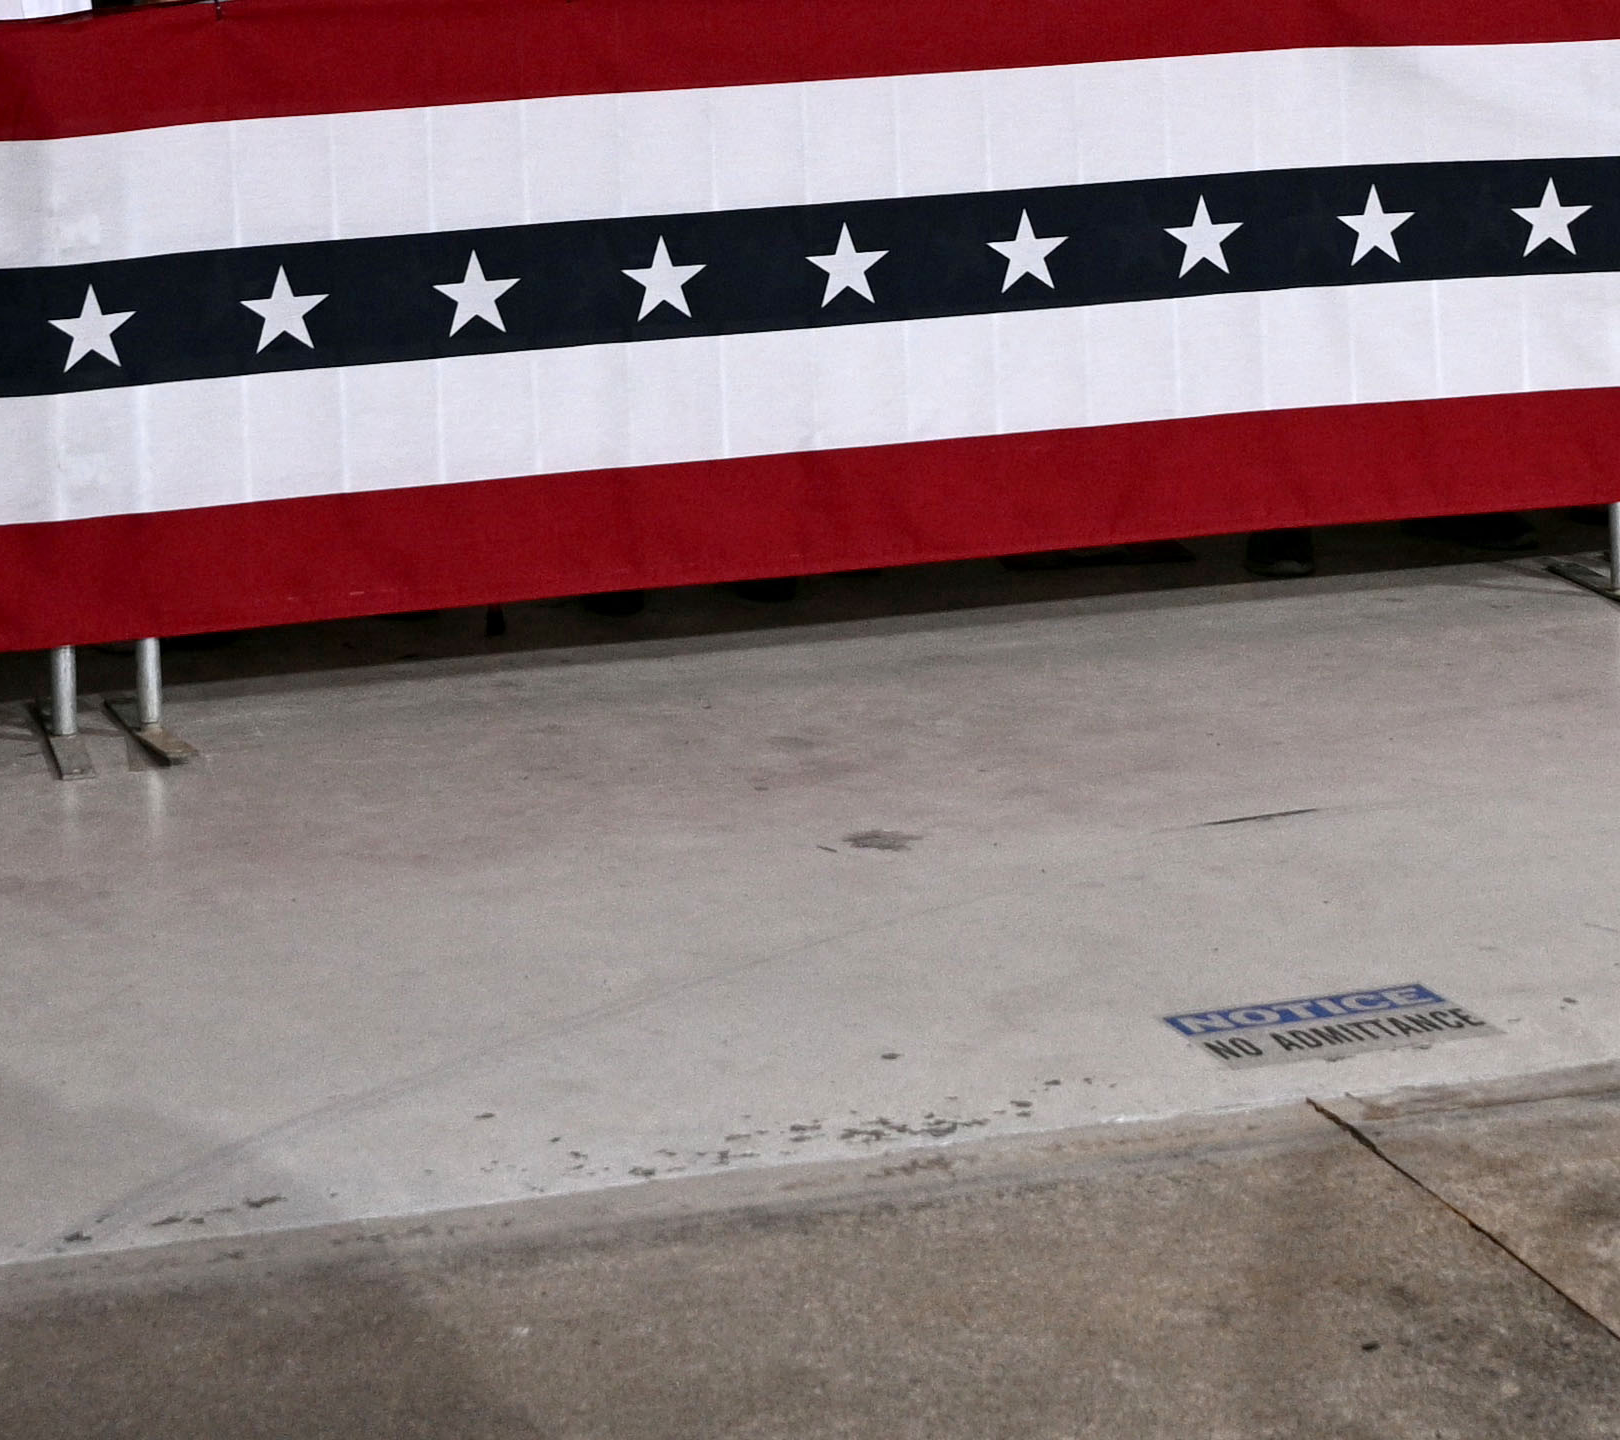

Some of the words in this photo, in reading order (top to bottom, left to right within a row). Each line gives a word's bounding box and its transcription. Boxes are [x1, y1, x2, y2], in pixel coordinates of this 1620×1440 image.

[1179, 984, 1436, 1034] NOTICE
[1204, 1037, 1264, 1061] NO
[1270, 1007, 1485, 1052] ADMITTANCE
